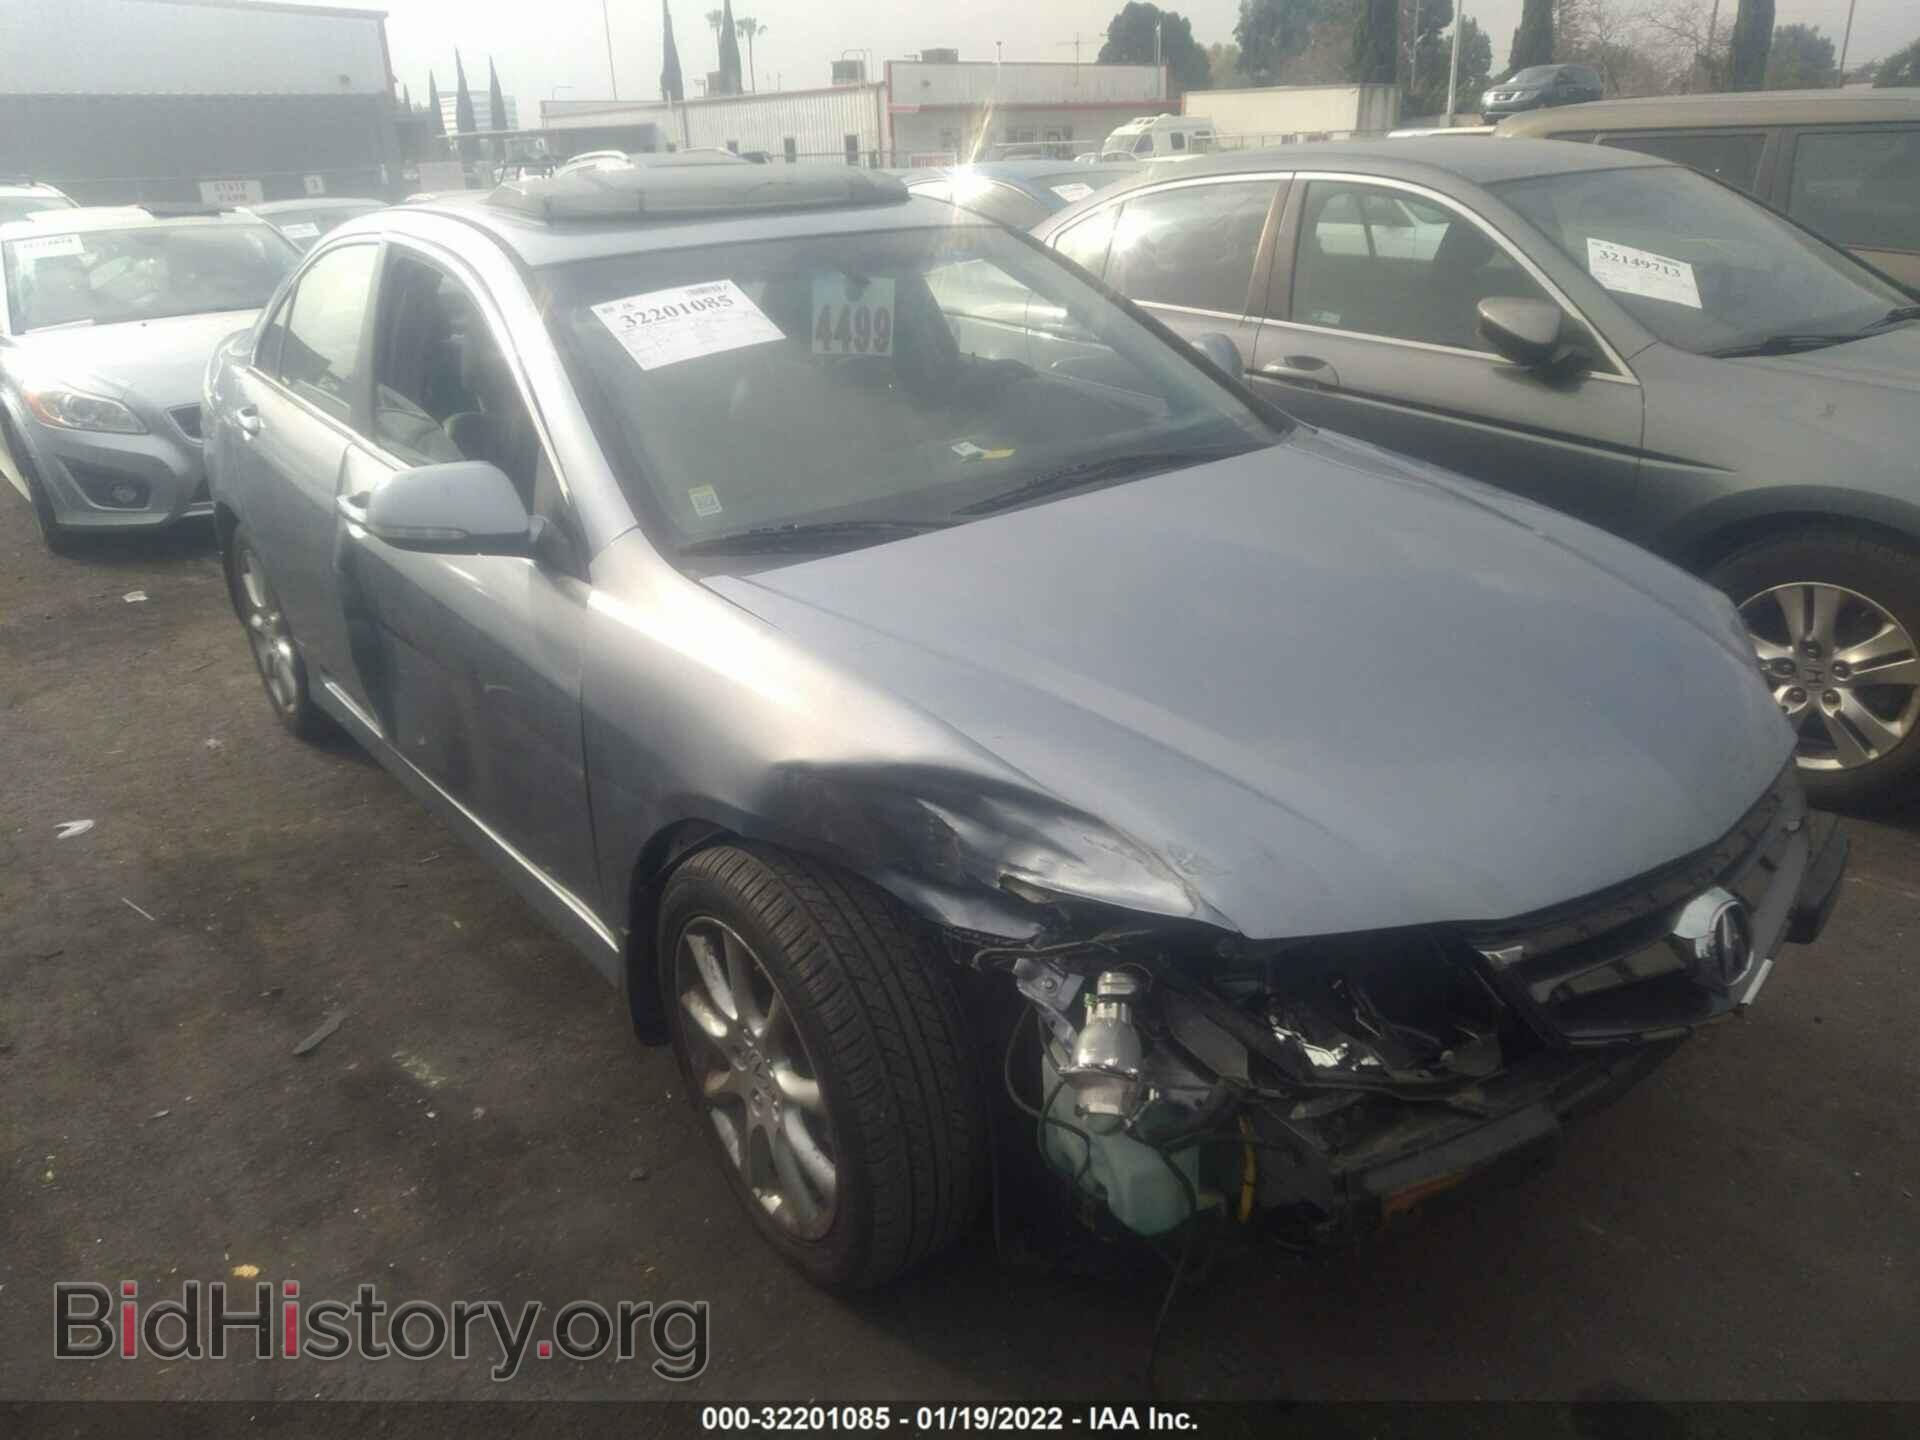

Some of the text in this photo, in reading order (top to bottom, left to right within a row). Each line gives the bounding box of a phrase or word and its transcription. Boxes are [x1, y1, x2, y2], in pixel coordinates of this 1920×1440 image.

[1599, 249, 1681, 277] 32149713
[620, 294, 735, 328] 32201085
[815, 304, 892, 353] 4499
